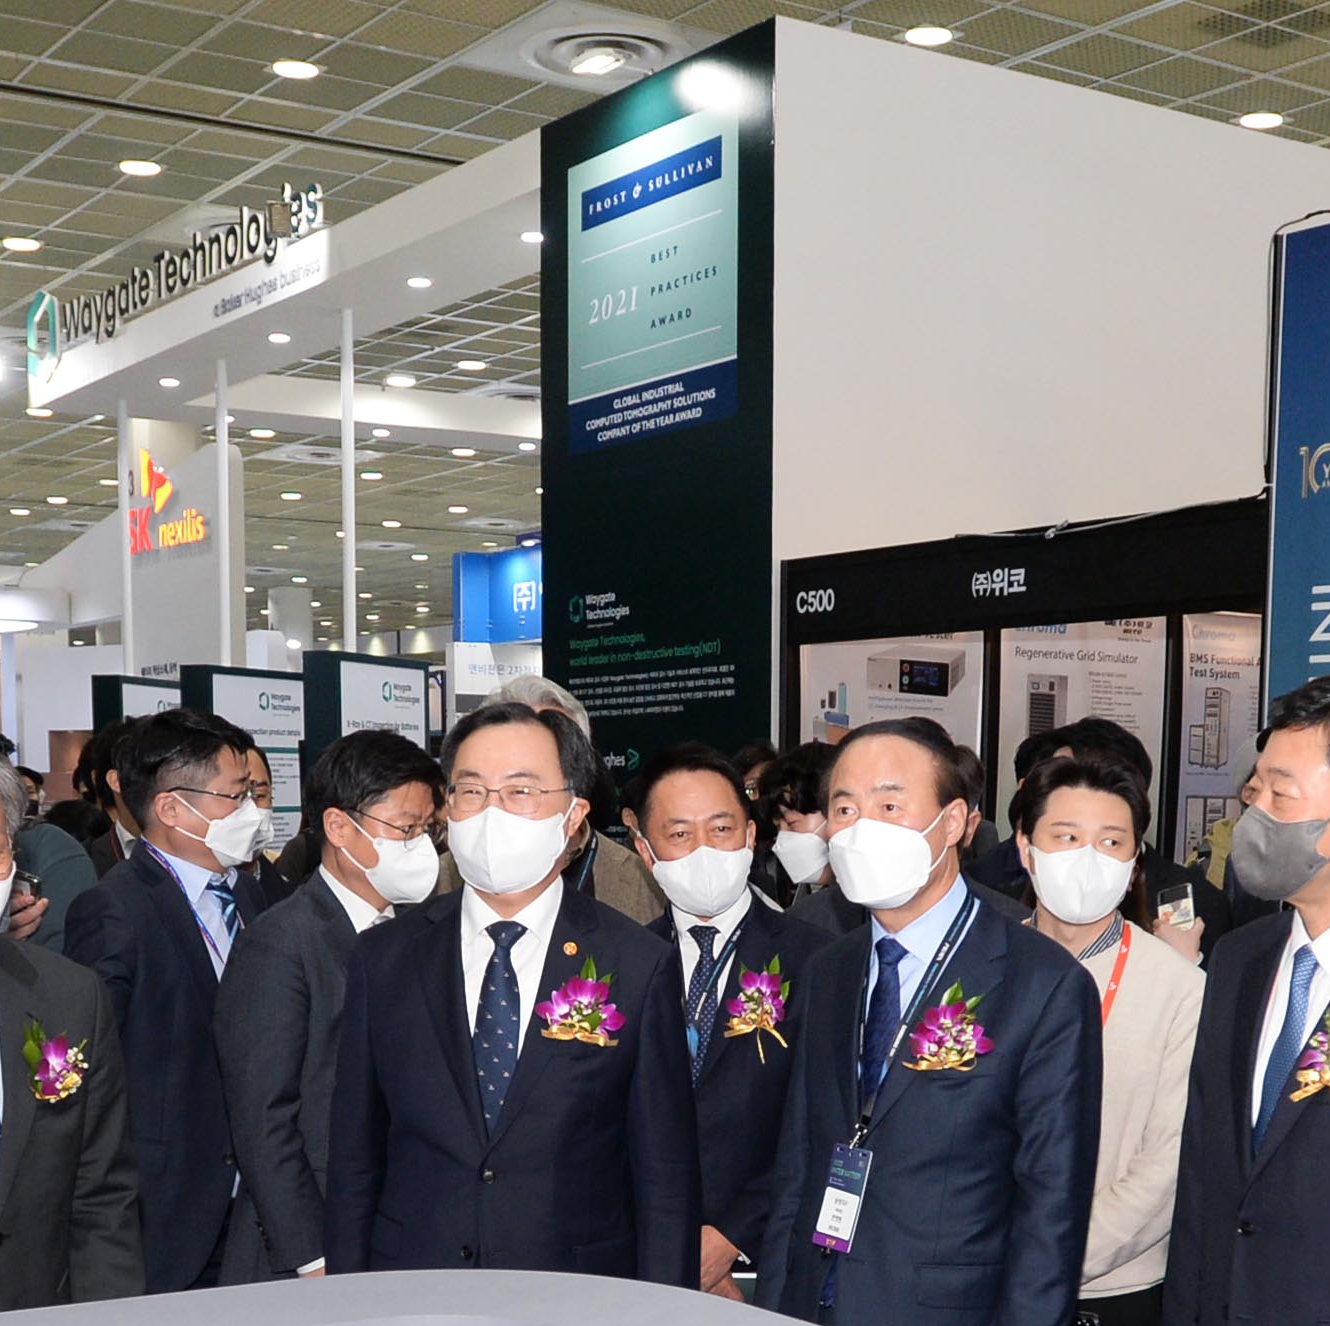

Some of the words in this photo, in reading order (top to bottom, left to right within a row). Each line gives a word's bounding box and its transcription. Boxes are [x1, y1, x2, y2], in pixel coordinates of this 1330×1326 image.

[589, 191, 627, 215] FROST
[632, 181, 643, 199] &
[648, 155, 713, 192] SULLIVAN
[63, 266, 153, 343] Waygate
[154, 183, 324, 299] Technologes
[650, 246, 678, 264] BEST
[650, 265, 718, 296] PRACTICES
[589, 285, 639, 325] 2021
[650, 308, 692, 329] AWARD
[585, 412, 623, 431] COMPUTED
[623, 402, 672, 420] TOMOGRAPHY
[673, 387, 716, 408] SOLUTIONS
[613, 393, 641, 409] GLOBAL
[641, 382, 684, 402] INDUSTRIAL
[597, 424, 630, 442] COMPANY
[631, 421, 642, 434] OF
[656, 414, 674, 427] YEAR
[674, 407, 702, 423] AWARD
[158, 508, 206, 548] nexilis
[972, 568, 1027, 599] (주)위코
[585, 592, 616, 606] Waygate
[586, 605, 630, 620] Technologies
[796, 589, 835, 614] C500
[1015, 646, 1075, 661] Regenerative
[1076, 649, 1095, 662] Grid
[1097, 651, 1139, 664] Simulator
[1190, 652, 1209, 664] BMS
[1211, 655, 1254, 667] Functional
[1190, 667, 1207, 678] Test
[1209, 669, 1240, 680] System
